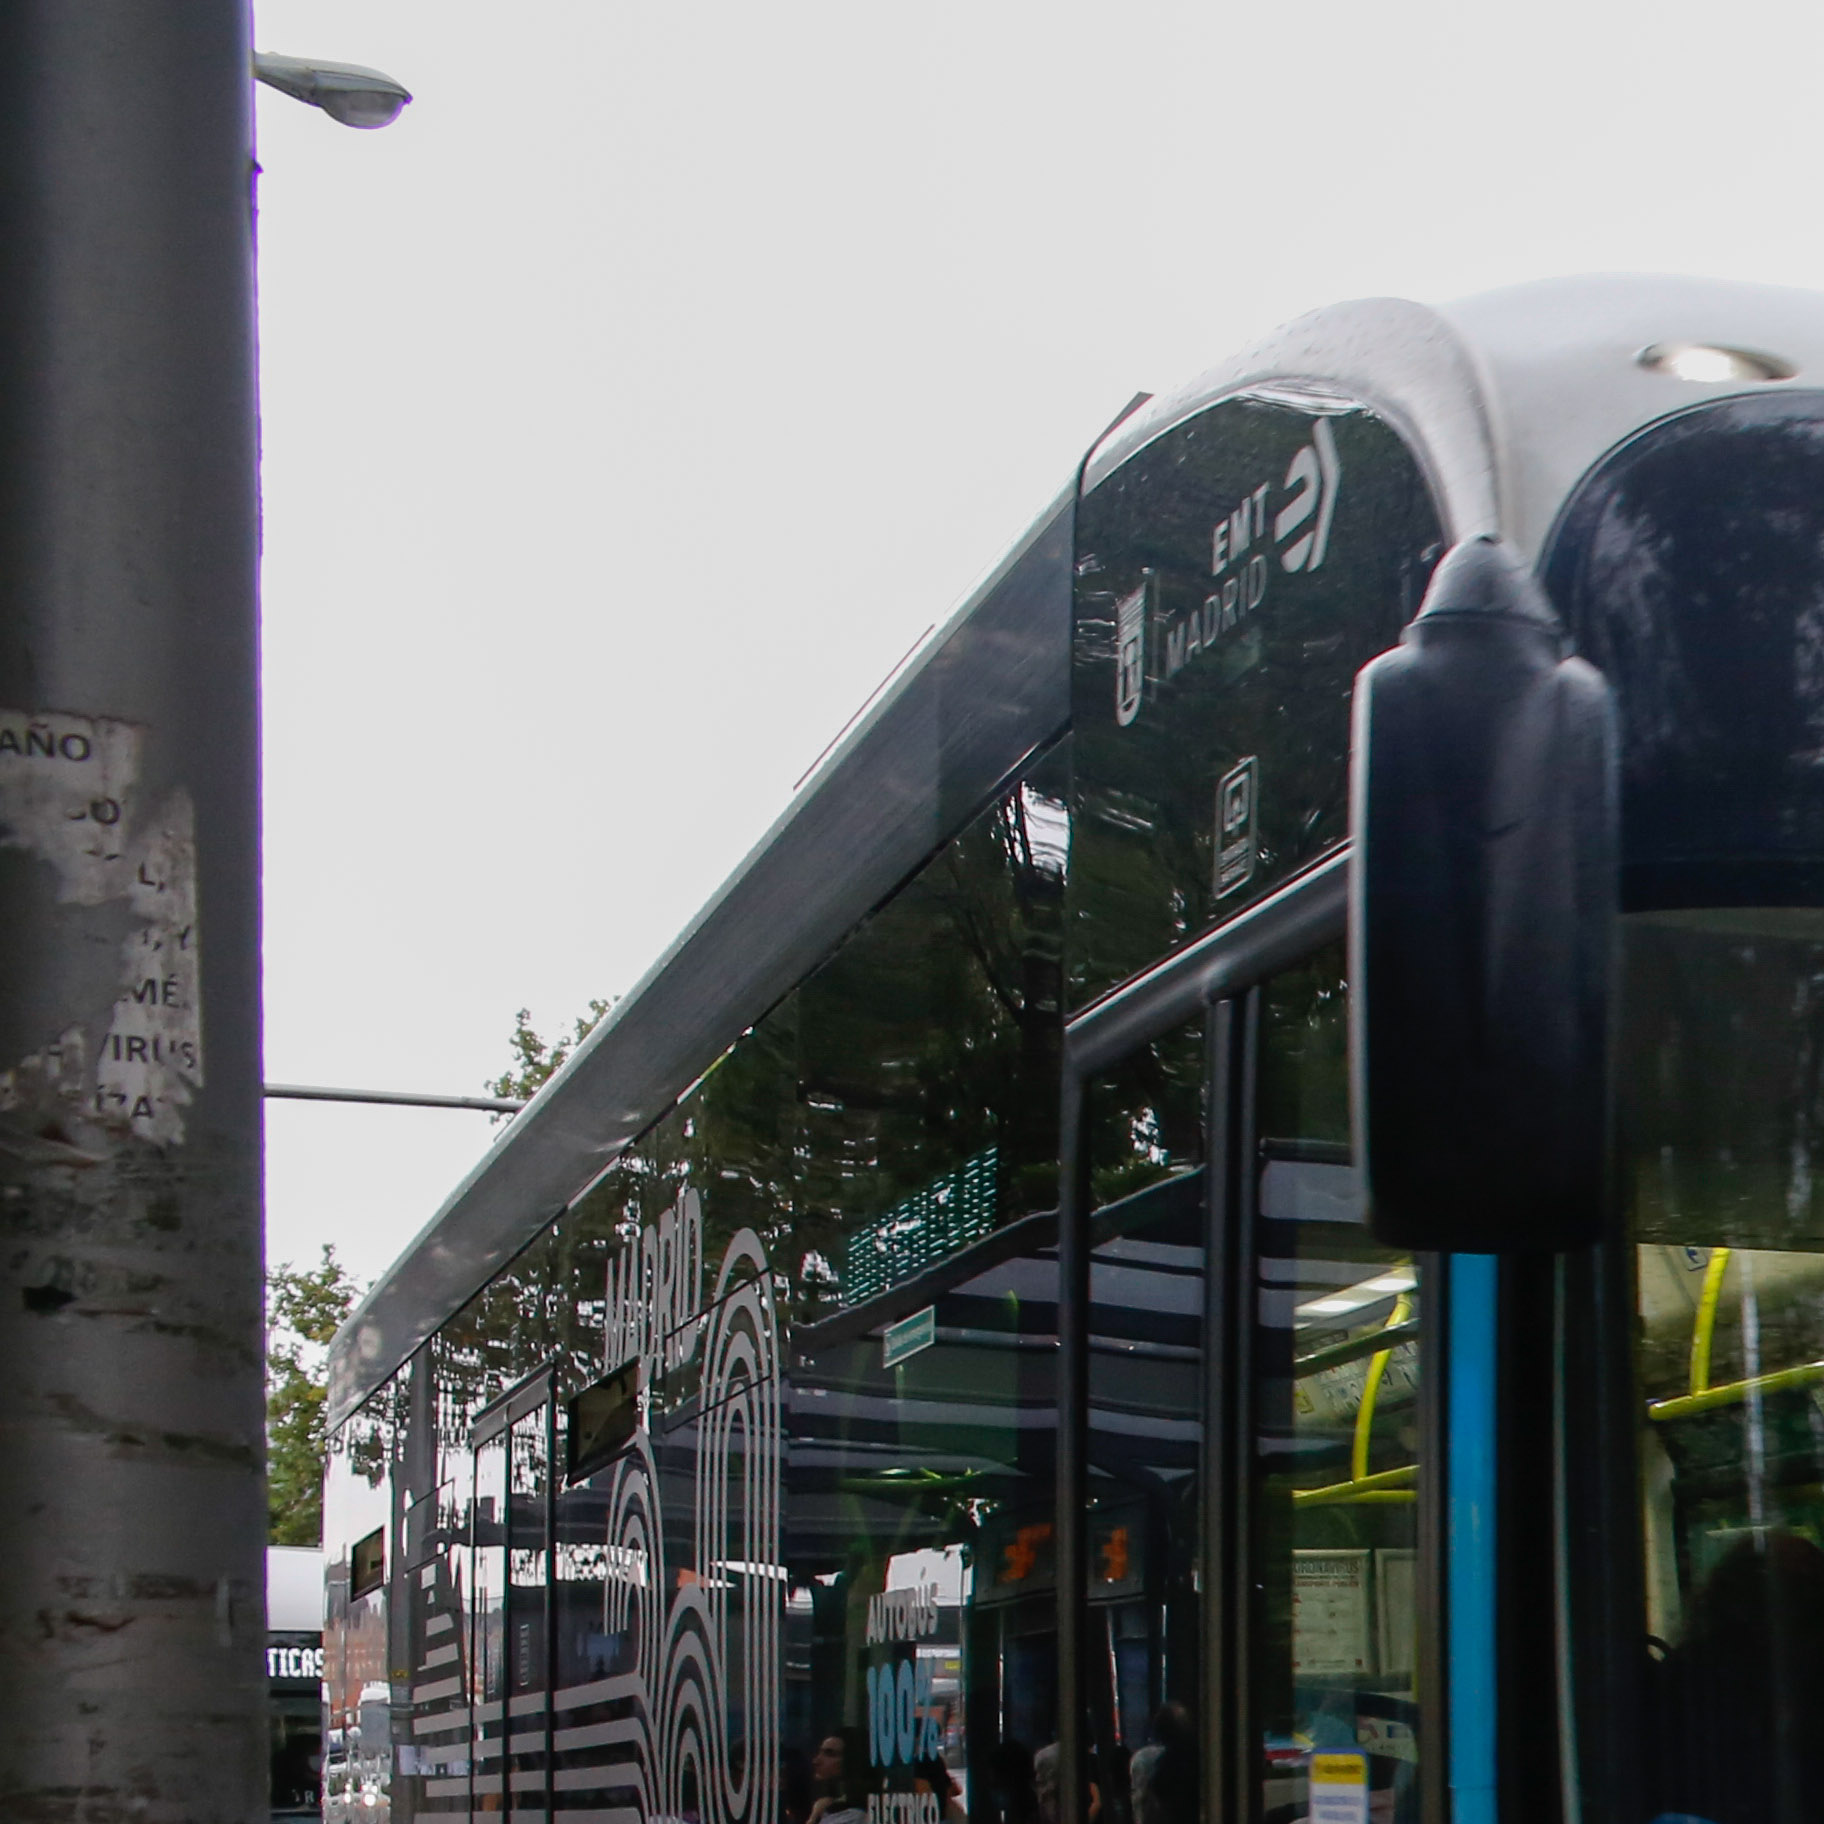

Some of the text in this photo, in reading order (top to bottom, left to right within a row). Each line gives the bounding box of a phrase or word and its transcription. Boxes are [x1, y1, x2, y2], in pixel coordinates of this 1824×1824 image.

[1212, 481, 1269, 576] EMT
[1166, 553, 1268, 679] MADRID
[866, 1566, 938, 1645] AUTOBÚS
[866, 1655, 939, 1768] 100%
